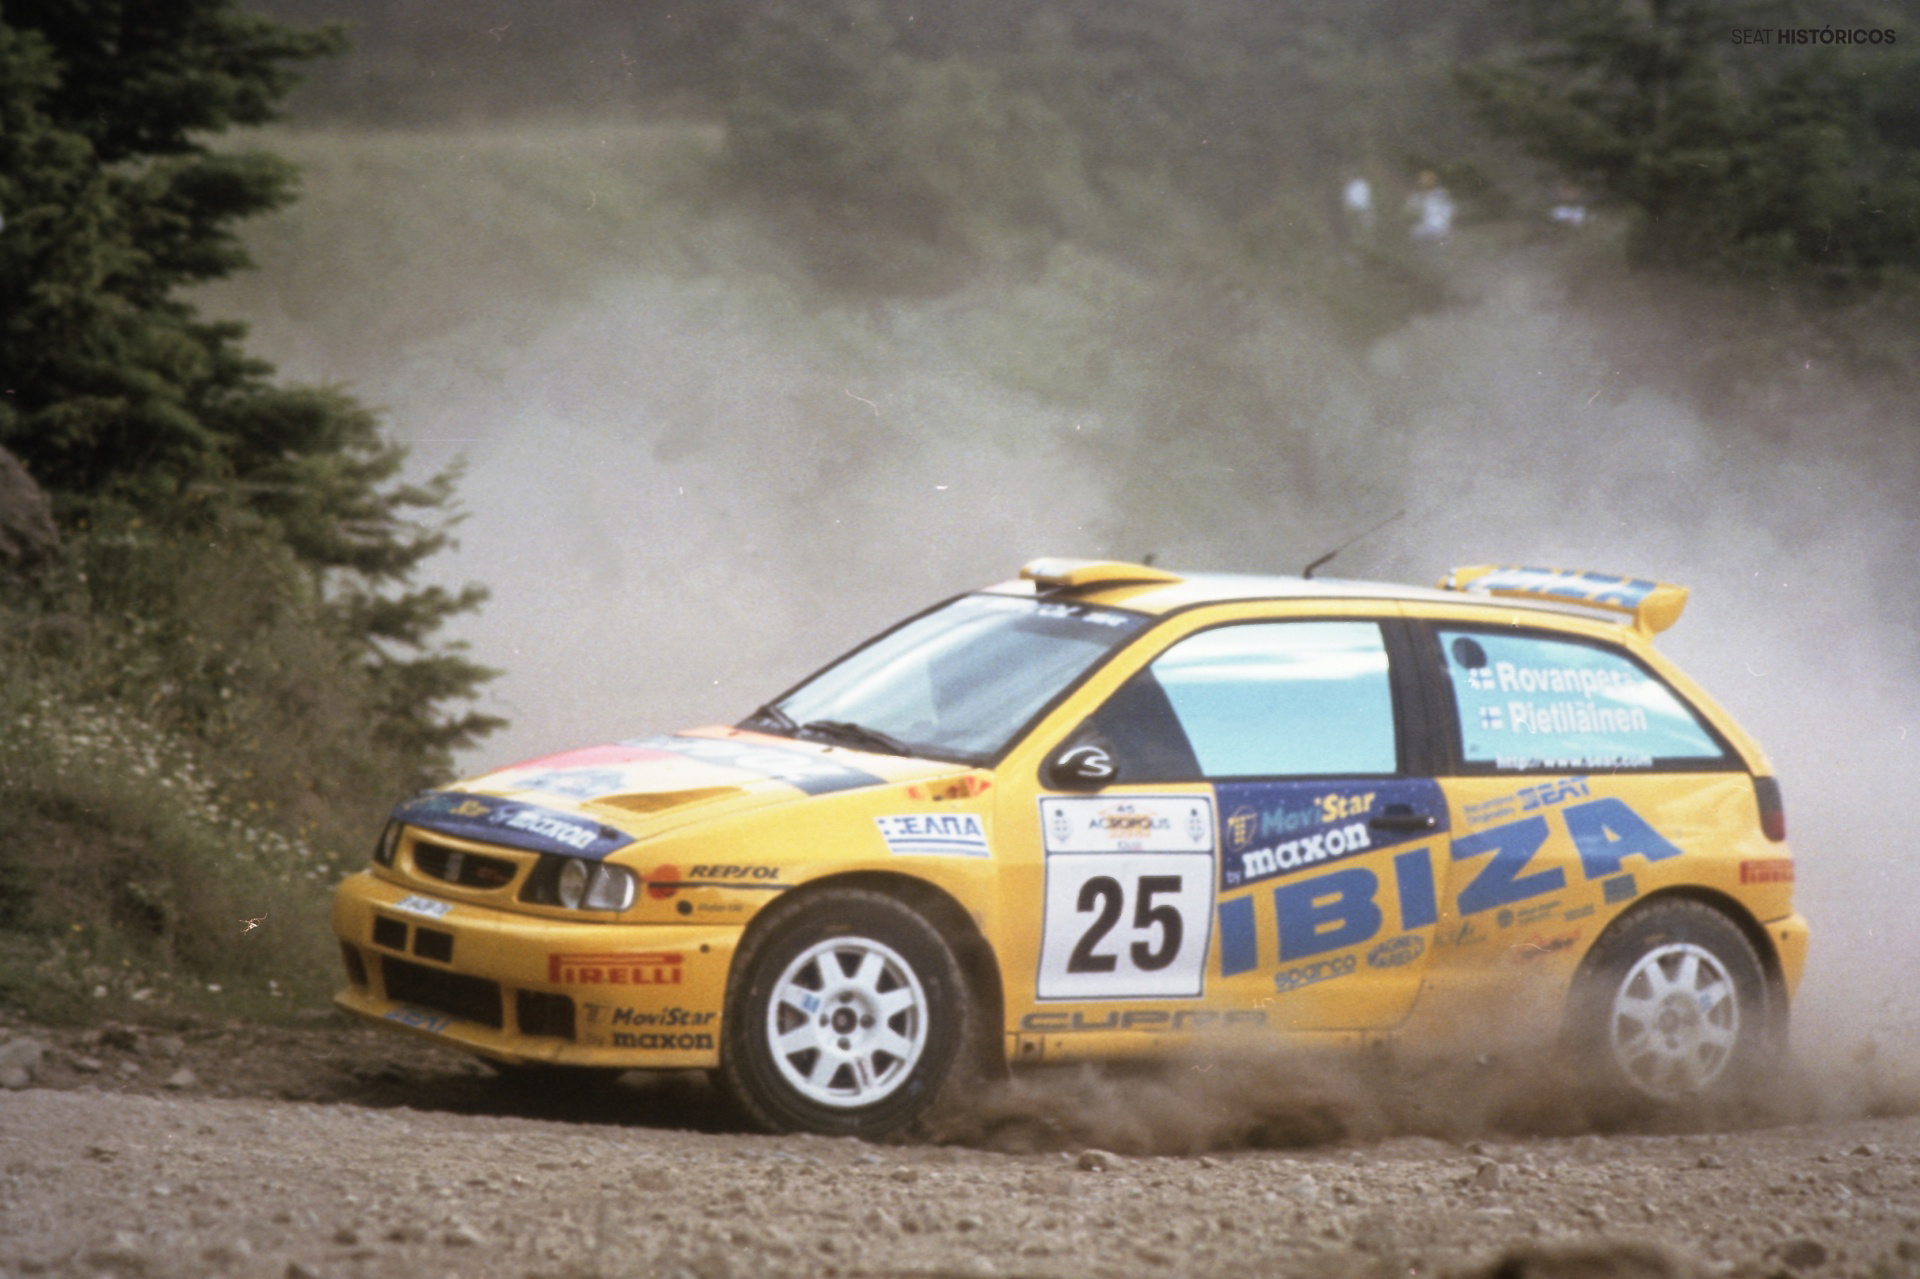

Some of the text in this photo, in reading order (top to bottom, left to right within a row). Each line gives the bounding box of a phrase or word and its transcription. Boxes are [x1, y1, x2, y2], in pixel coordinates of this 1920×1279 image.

[1261, 792, 1376, 838] MoviStar
[1242, 822, 1371, 879] maxon
[688, 864, 781, 880] REPSOL
[1216, 798, 1685, 979] IBIZA
[1066, 875, 1184, 974] 25
[547, 952, 684, 985] PIRELLI
[1273, 954, 1358, 993] sparco
[611, 1006, 717, 1027] MoviStar
[612, 1031, 714, 1050] maxon
